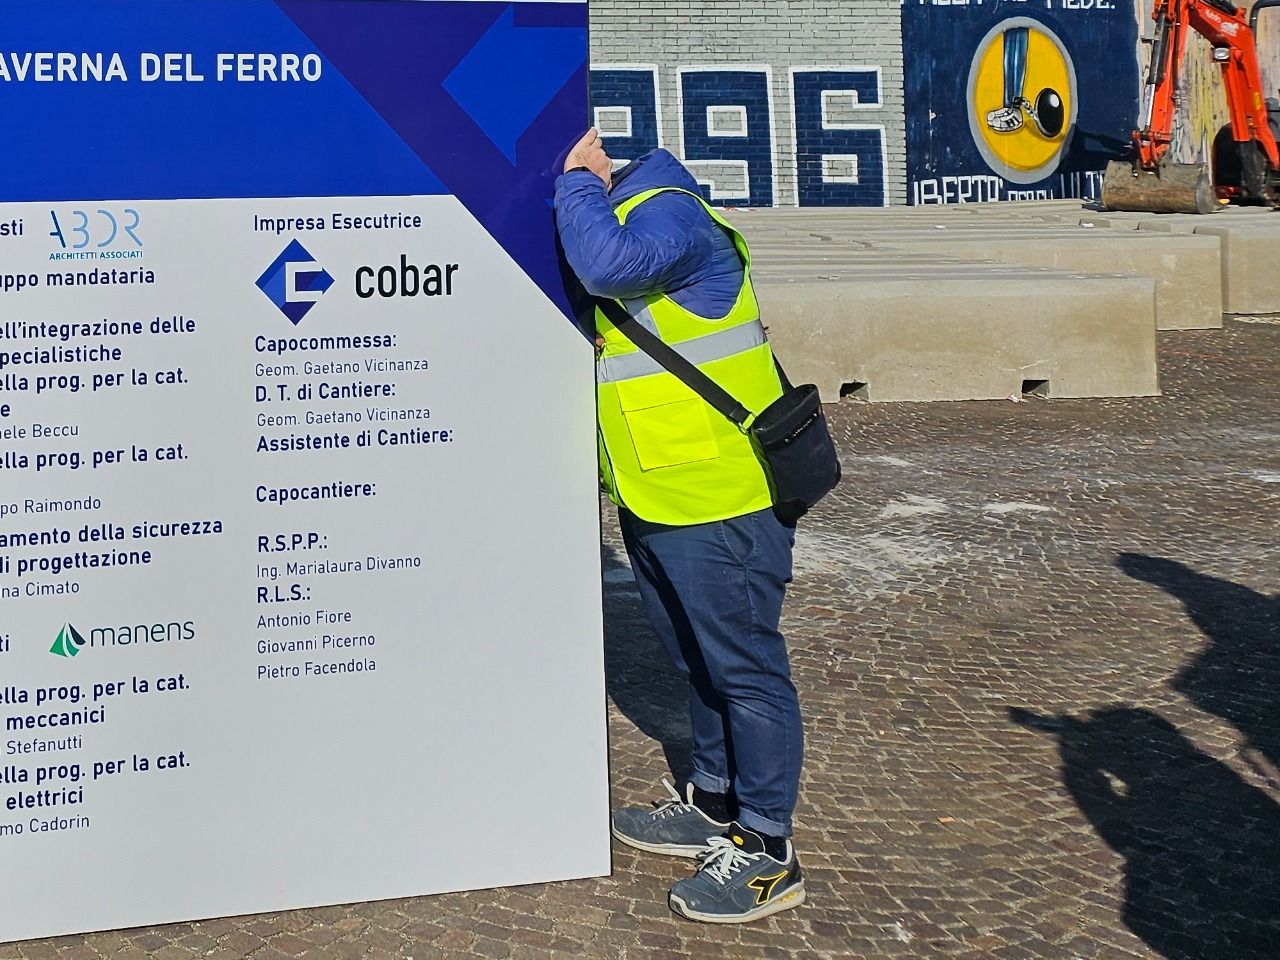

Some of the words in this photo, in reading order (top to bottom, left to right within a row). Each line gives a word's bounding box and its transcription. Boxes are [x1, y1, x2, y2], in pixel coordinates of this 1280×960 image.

[140, 52, 204, 82] DEL
[217, 53, 322, 82] FERRO
[49, 209, 143, 249] ABDR
[254, 214, 325, 236] Impresa
[332, 213, 422, 230] Esecutrice
[48, 251, 97, 261] ARCHITETTI
[99, 250, 143, 259] ASSOCIATI
[46, 267, 155, 286] mandataria
[355, 253, 459, 299] cobar
[149, 315, 196, 334] delle
[255, 334, 397, 356] Capocommessa:
[255, 363, 299, 377] Geom.
[304, 361, 360, 375] Gaetano
[364, 358, 428, 373] Vicinanza
[32, 423, 79, 438] Beccu
[256, 432, 350, 453] Assistente
[356, 430, 371, 448] di
[377, 428, 453, 446] Cantiere:
[256, 482, 376, 506] Capocantiere:
[78, 523, 125, 543] della
[132, 520, 223, 539] sicurezza
[258, 532, 328, 553] R.S.P.P.:
[17, 550, 152, 578] progettazione
[256, 564, 282, 581] Ing.
[286, 559, 362, 576] Marialaura
[366, 556, 421, 571] Divanno
[257, 583, 311, 604] R.L.S.:
[256, 614, 311, 629] Antonio
[316, 610, 352, 624] Fiore
[90, 620, 195, 648] manens
[257, 639, 317, 654] Giovanni
[322, 635, 375, 649] Picerno
[257, 664, 300, 680] Pietro
[305, 657, 376, 676] Facendola
[6, 709, 105, 731] meccanici
[6, 789, 83, 811] elettrici
[29, 816, 90, 833] Cadorin
